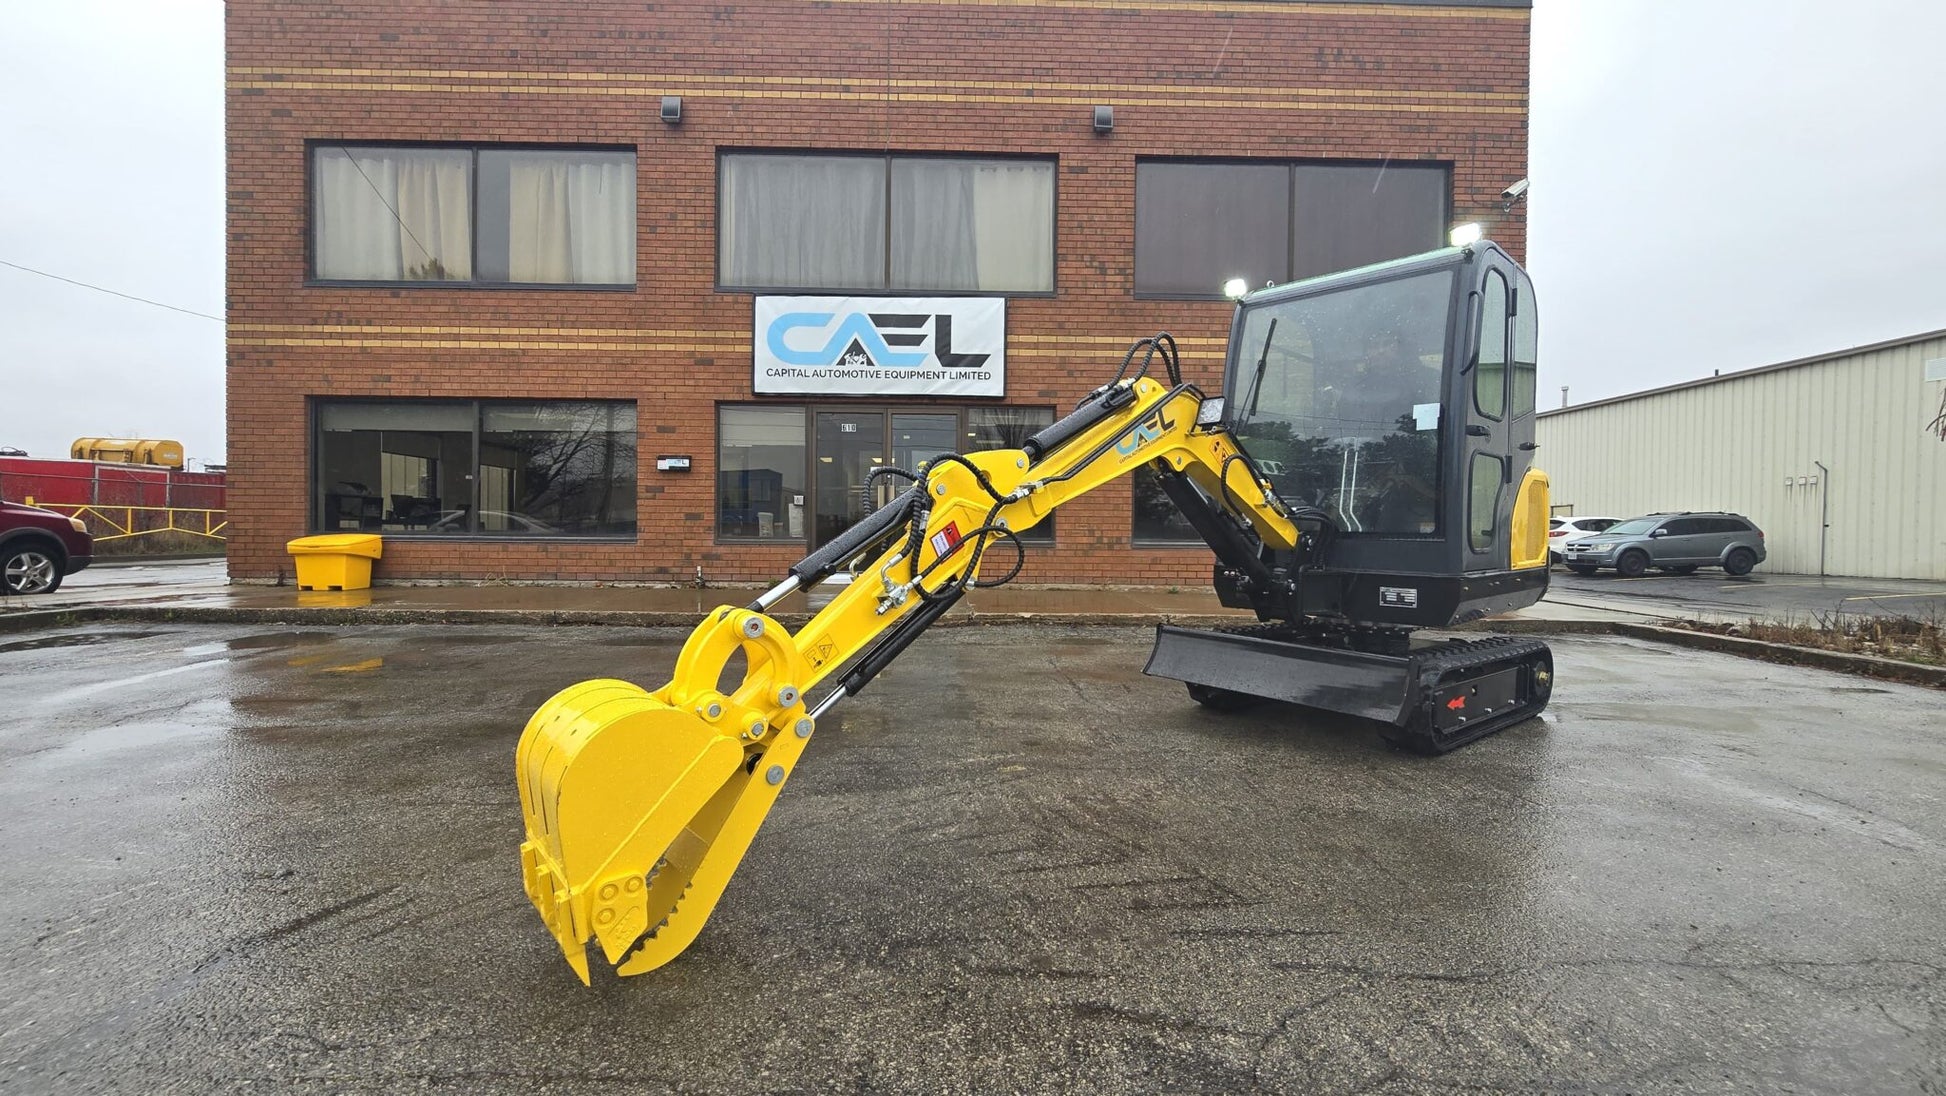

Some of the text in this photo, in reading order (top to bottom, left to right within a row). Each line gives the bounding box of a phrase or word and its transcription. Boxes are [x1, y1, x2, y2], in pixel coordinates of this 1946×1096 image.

[767, 312, 991, 368] CAEL
[766, 368, 992, 381] CAPITAL AUTOMOTIVE EQUIPMENT LIMITED
